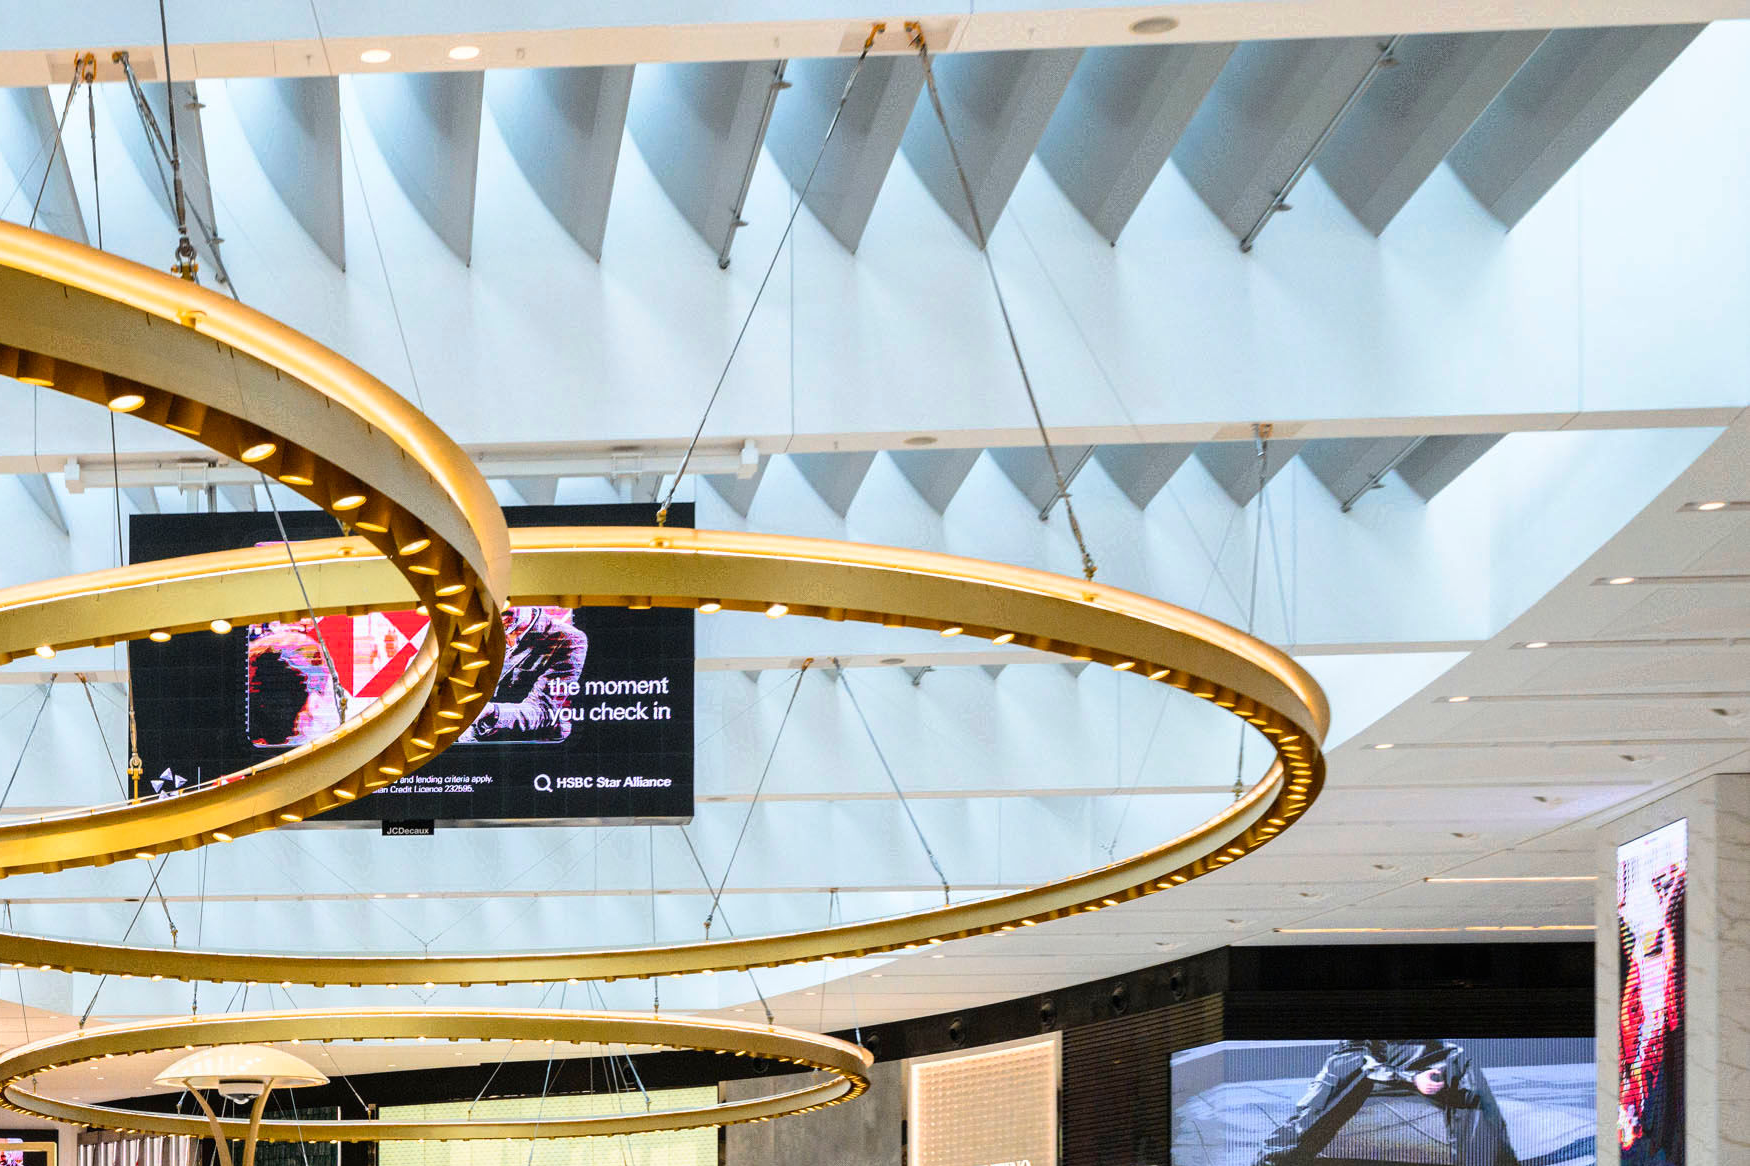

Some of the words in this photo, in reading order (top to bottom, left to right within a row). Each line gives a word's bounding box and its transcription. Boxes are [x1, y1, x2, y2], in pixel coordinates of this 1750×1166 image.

[548, 677, 580, 696] the
[585, 676, 670, 695] moment
[548, 706, 585, 726] you
[589, 701, 649, 721] check
[653, 701, 672, 720] in
[400, 776, 414, 784] and
[416, 775, 443, 784] lending
[444, 775, 470, 783] criteria
[556, 777, 593, 789] HSBC
[596, 776, 621, 788] Star
[623, 776, 672, 788] Alliance
[390, 785, 412, 793] Credit
[414, 785, 442, 793] Licence
[387, 827, 430, 835] JCDecaux
